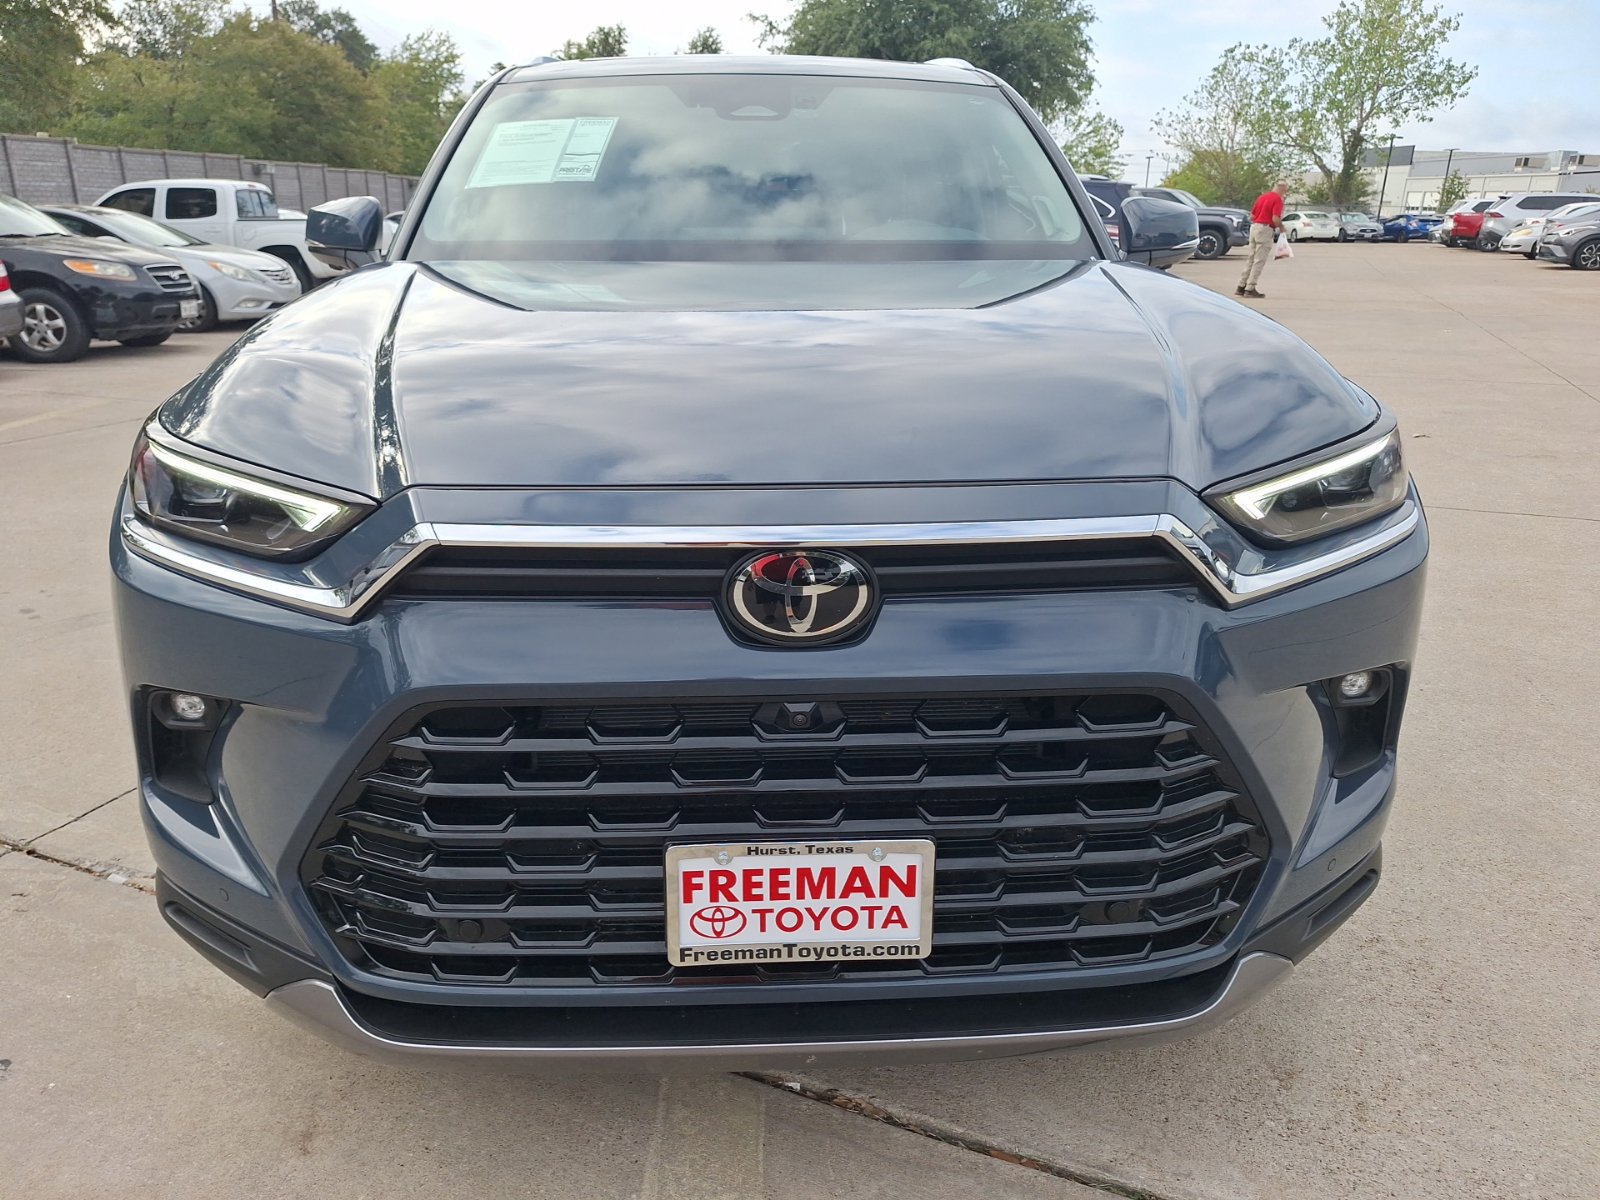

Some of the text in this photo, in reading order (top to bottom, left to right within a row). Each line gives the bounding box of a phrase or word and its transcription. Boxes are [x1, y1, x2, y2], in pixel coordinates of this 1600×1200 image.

[747, 845, 854, 856] Hurst, Texas
[682, 864, 917, 904] FREEMAN
[752, 905, 908, 932] TOYOTA
[680, 943, 920, 962] FreemanToyota.com
